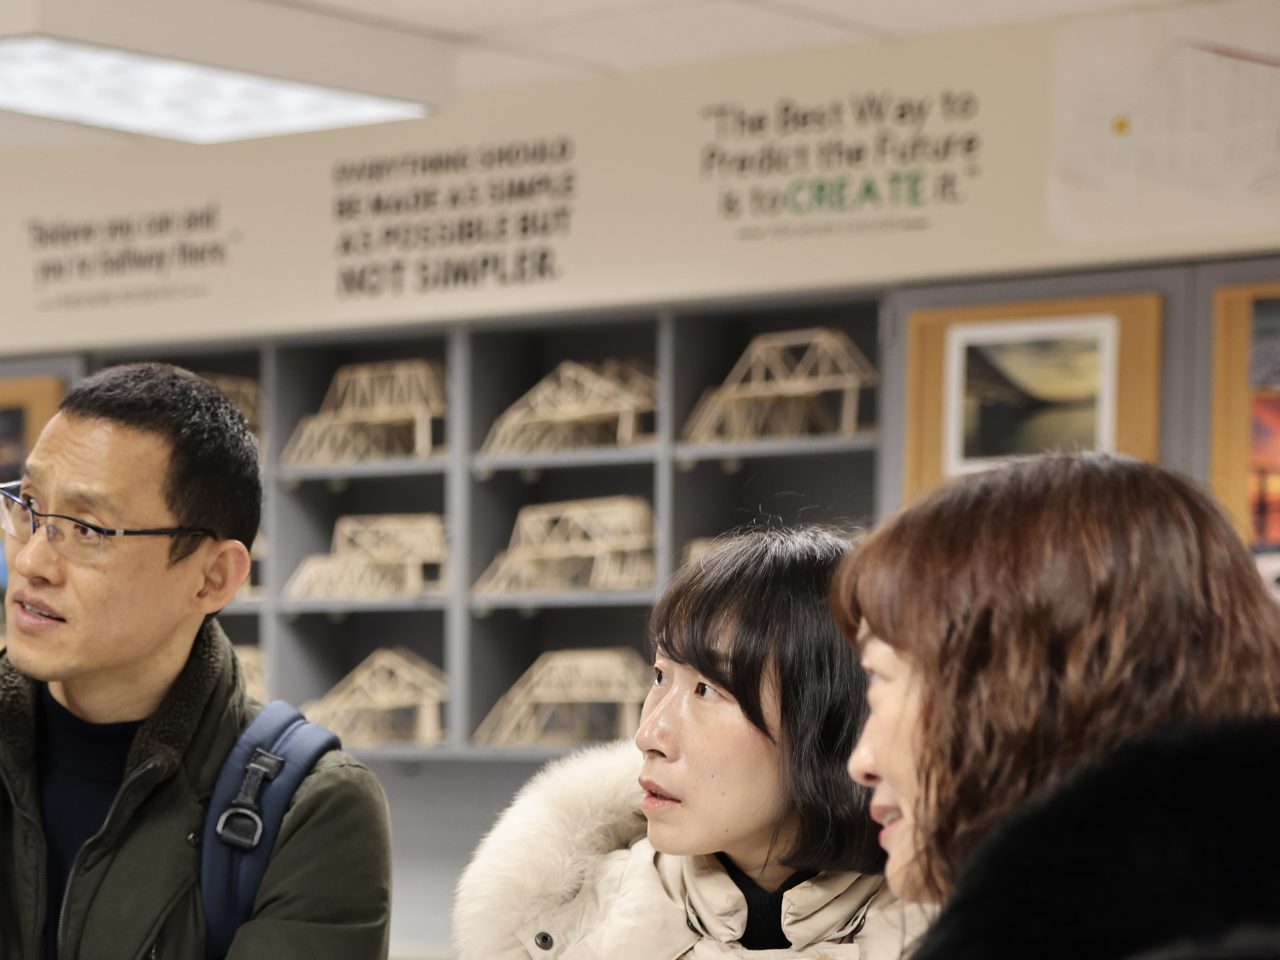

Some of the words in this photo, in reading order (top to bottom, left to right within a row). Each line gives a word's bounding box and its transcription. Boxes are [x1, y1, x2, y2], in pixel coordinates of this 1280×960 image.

[774, 98, 845, 134] Best
[848, 90, 933, 131] Way
[940, 90, 980, 121] to
[480, 136, 574, 168] SHOULD
[700, 141, 810, 179] Predict
[816, 138, 867, 170] the
[872, 128, 981, 165] Future
[334, 197, 362, 221] BE
[370, 189, 439, 218] MADE
[447, 182, 478, 208] AS
[488, 170, 575, 202] SIMPLE
[748, 186, 786, 216] to
[786, 168, 925, 215] CREATE
[336, 228, 371, 255] AS
[382, 215, 509, 247] POSSIBLE
[519, 206, 570, 237] BUT
[337, 258, 405, 296] NOT
